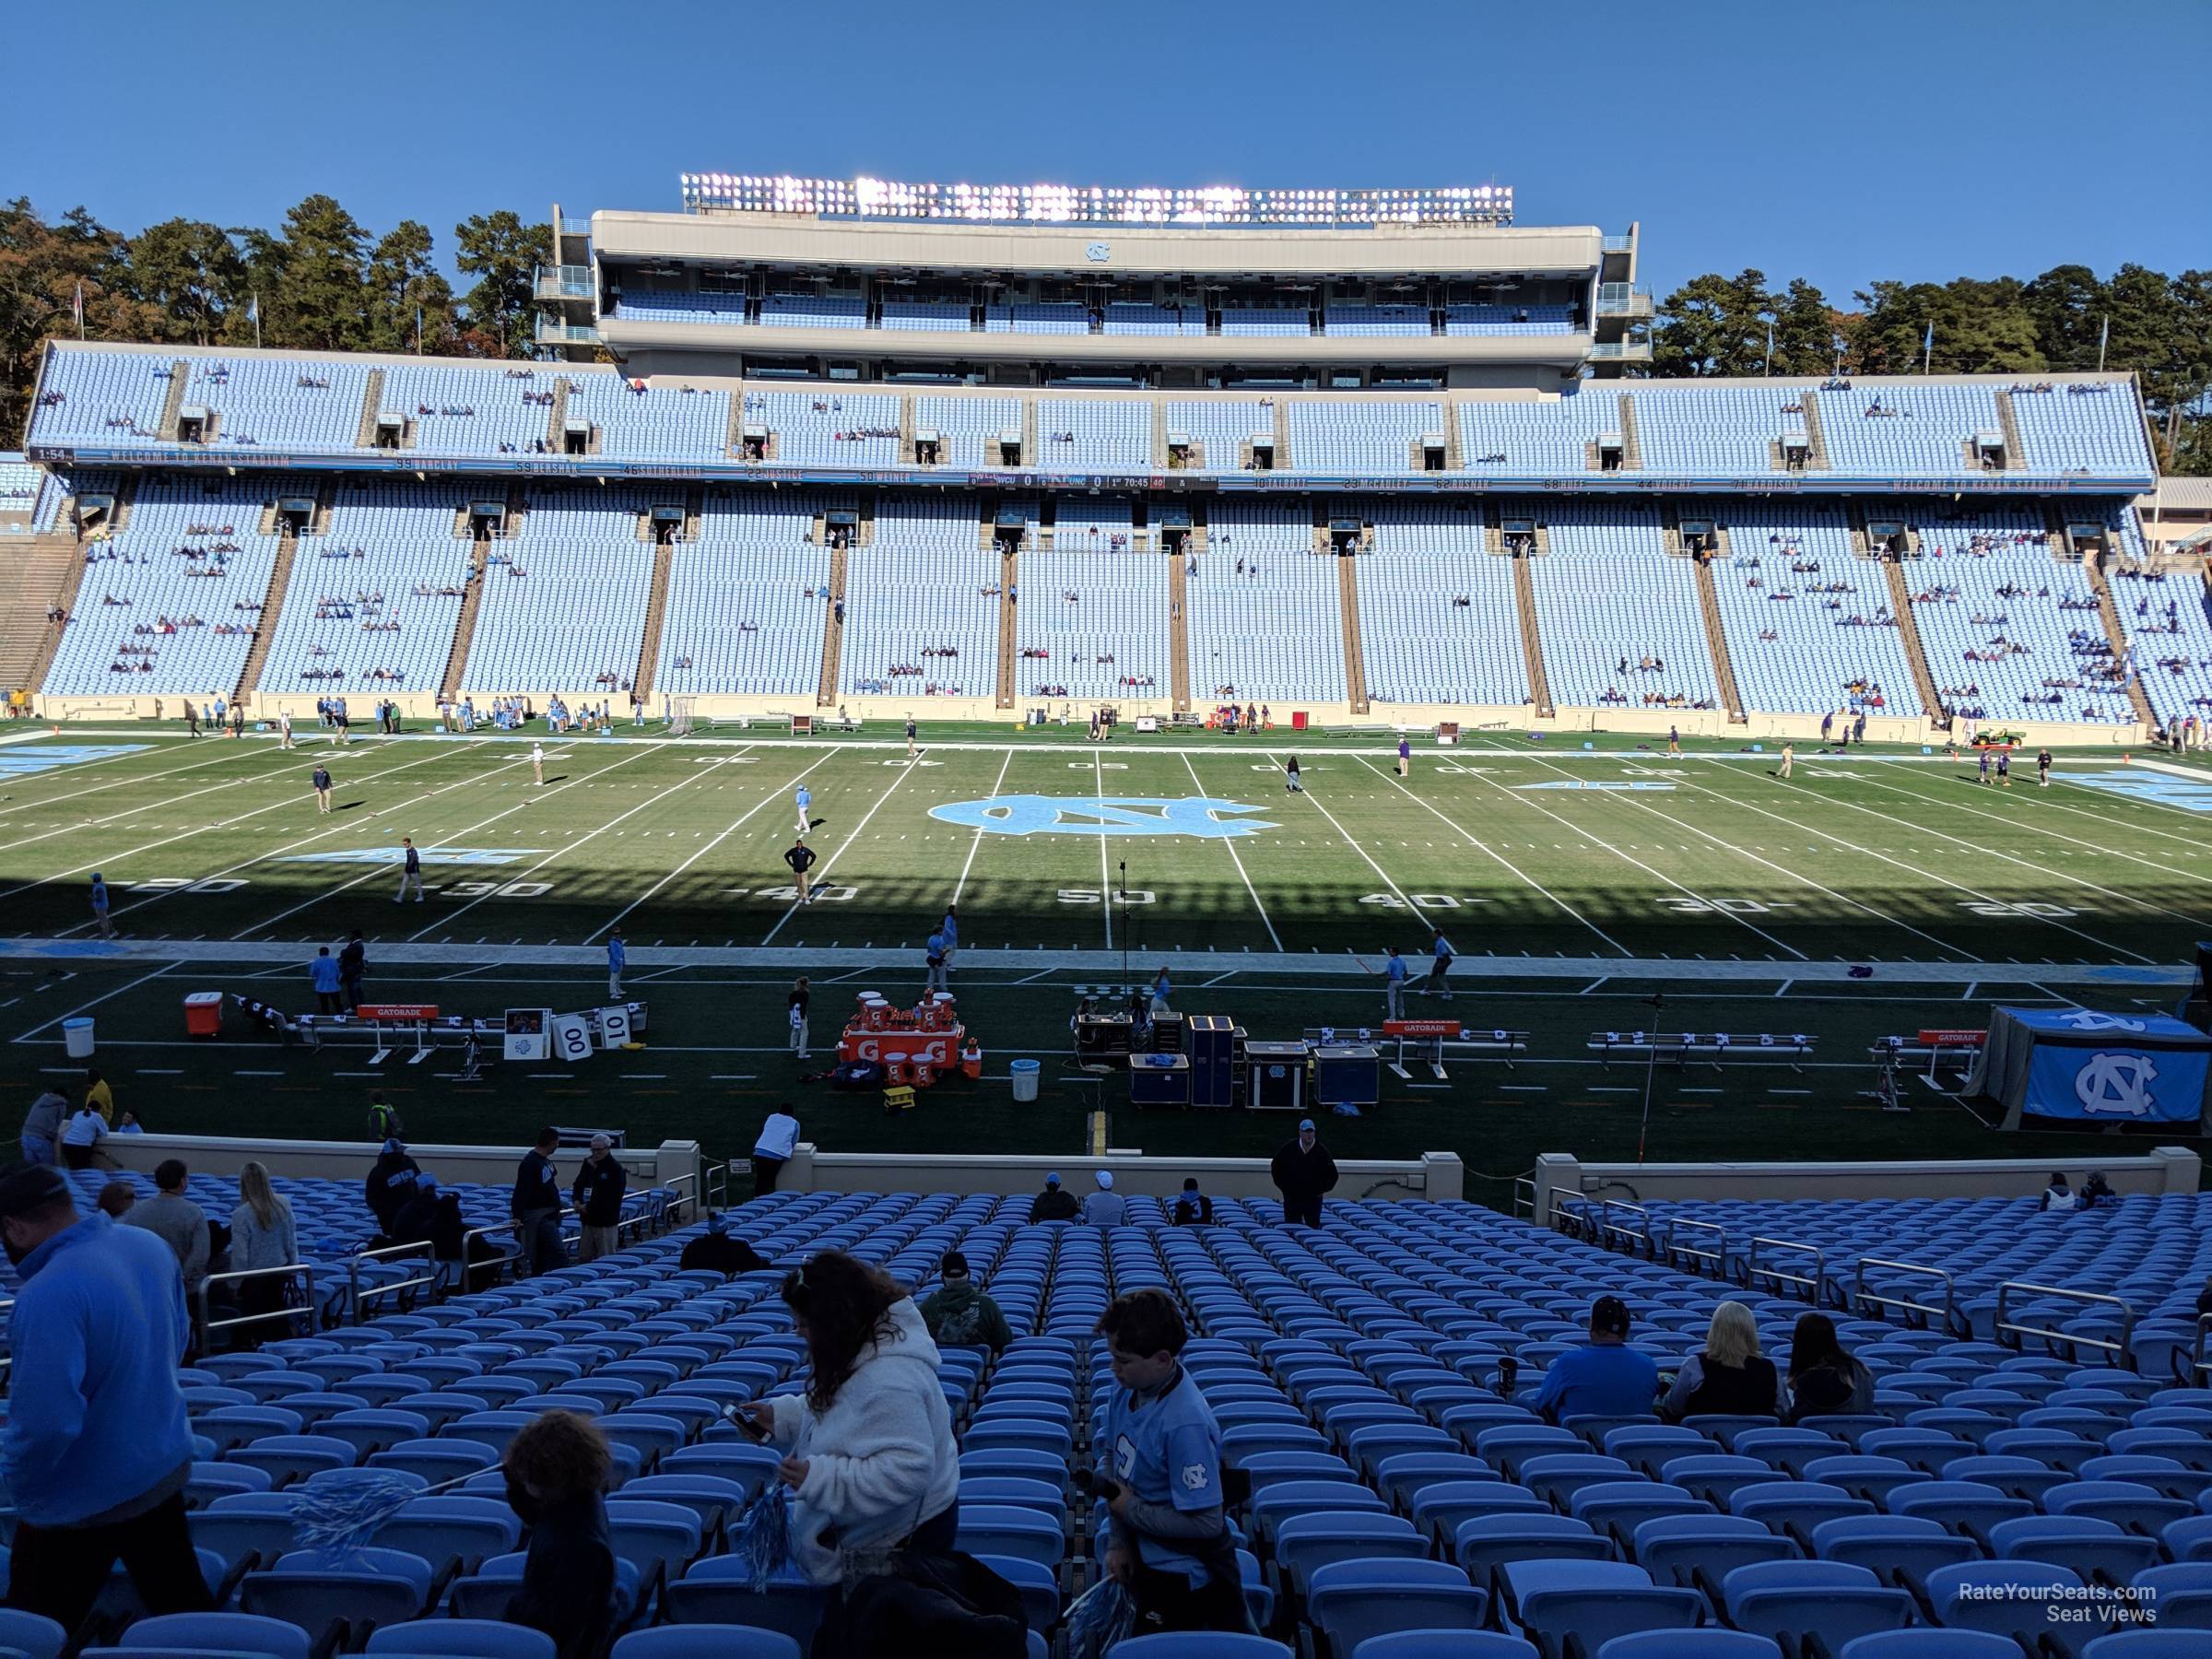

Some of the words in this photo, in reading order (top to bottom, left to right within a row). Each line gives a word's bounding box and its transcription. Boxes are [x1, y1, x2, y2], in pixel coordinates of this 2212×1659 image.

[39, 449, 65, 460] 1:54
[112, 451, 170, 463] WELCOME
[176, 452, 188, 464] TO
[194, 453, 232, 465] KENAN
[237, 454, 290, 465] STADIUM
[396, 458, 412, 469] 99
[412, 459, 458, 471] BARCLAY
[517, 462, 531, 473] 59
[533, 463, 578, 474] BERSHAK
[624, 465, 638, 476] 46
[640, 465, 702, 477] SUTHERLAND
[747, 469, 762, 479] 22
[764, 469, 803, 480] JUSTICE
[860, 471, 874, 481] 50
[876, 472, 911, 483] WEINER
[998, 476, 1016, 485] WCU
[1025, 475, 1031, 487] 0
[1069, 476, 1086, 487] UNC
[1094, 476, 1101, 488] 0
[1124, 477, 1148, 488] 70:45
[1153, 478, 1163, 487] 40
[1268, 479, 1307, 489] TALBOTT
[1344, 479, 1358, 489] 23
[1436, 479, 1451, 490] 62
[1452, 479, 1490, 490] RUSNAK
[1544, 479, 1559, 490] 68
[1560, 479, 1585, 490] HUFF
[1638, 479, 1653, 490] 44
[1655, 479, 1692, 490] VOIGHT
[1747, 479, 1799, 491] HARDISON
[1892, 479, 1947, 491] WELCOME
[1954, 479, 1967, 491] TO
[1971, 479, 2011, 491] KENAN
[2015, 479, 2070, 491] STADIUM
[127, 877, 251, 893] 20
[439, 882, 555, 897] 30
[755, 886, 858, 900] 40
[1057, 888, 1156, 905] 50
[1358, 893, 1463, 909] 40
[1655, 898, 1771, 913] 30
[1956, 901, 2079, 918] 20
[377, 1008, 422, 1017] GATORADE
[871, 1012, 881, 1020] G
[924, 1012, 935, 1021] G
[1404, 1024, 1446, 1032] GATORADE
[565, 1027, 586, 1054] 00
[1938, 1033, 1979, 1042] GATORADE
[857, 1040, 879, 1062] G
[925, 1041, 947, 1064] G
[889, 1065, 899, 1075] G
[918, 1065, 928, 1076] G
